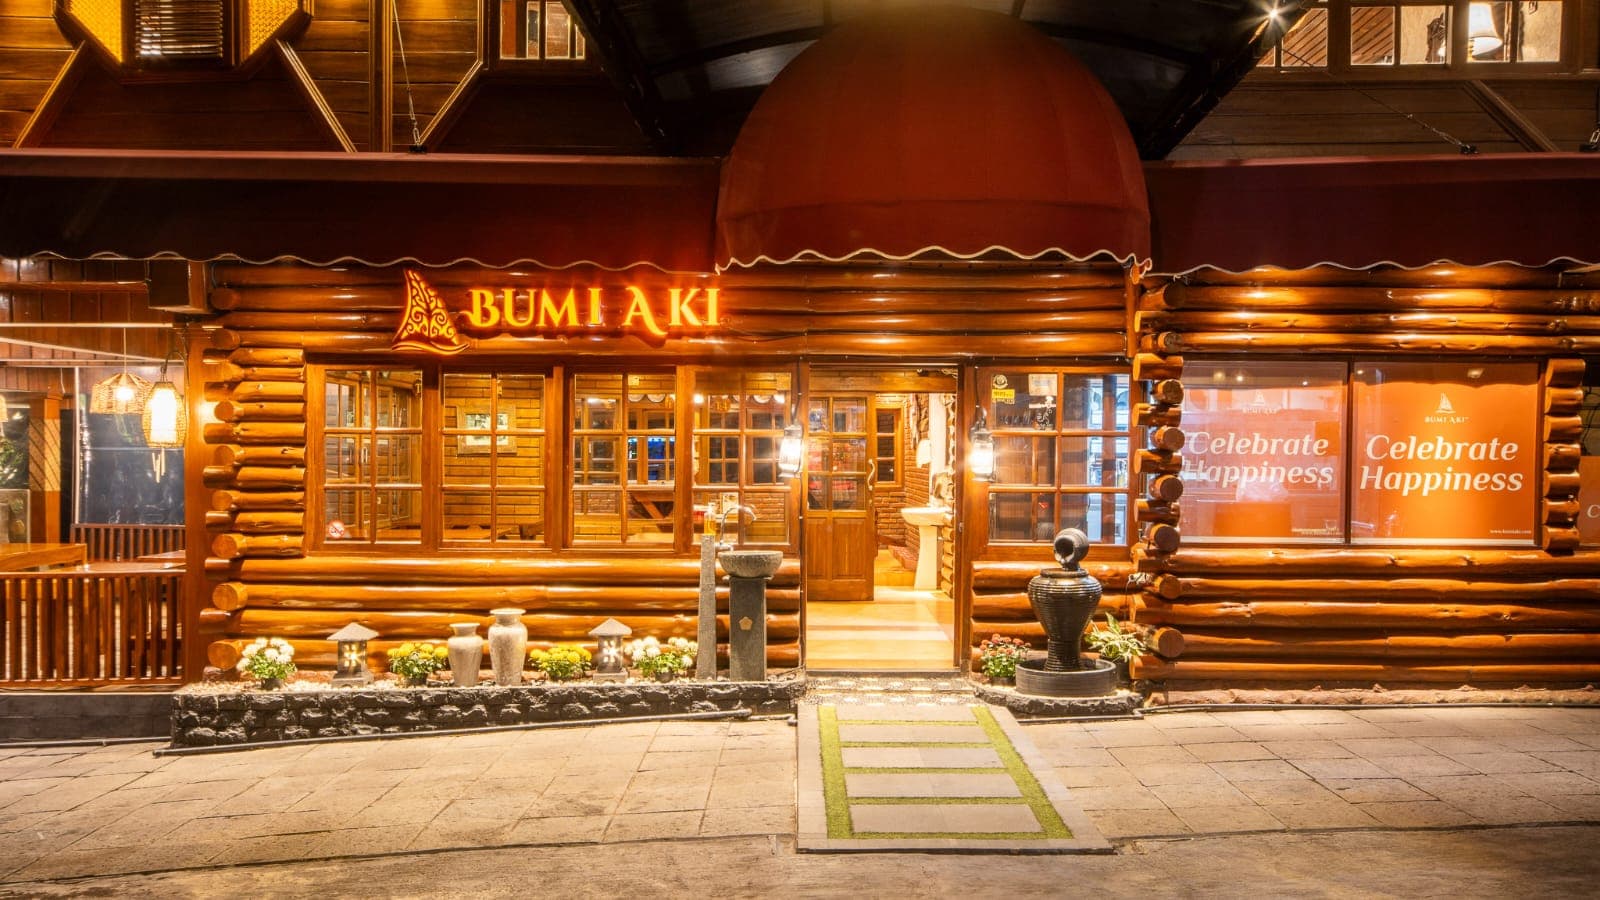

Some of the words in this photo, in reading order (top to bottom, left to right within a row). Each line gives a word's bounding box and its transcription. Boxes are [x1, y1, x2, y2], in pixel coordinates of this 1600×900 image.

[460, 287, 605, 327] BUMI
[622, 286, 720, 335] AKI
[1188, 432, 1328, 456] Celebrate
[1366, 435, 1519, 461] Celebrate
[1183, 459, 1333, 489] Happiness
[1360, 466, 1523, 497] Happiness
